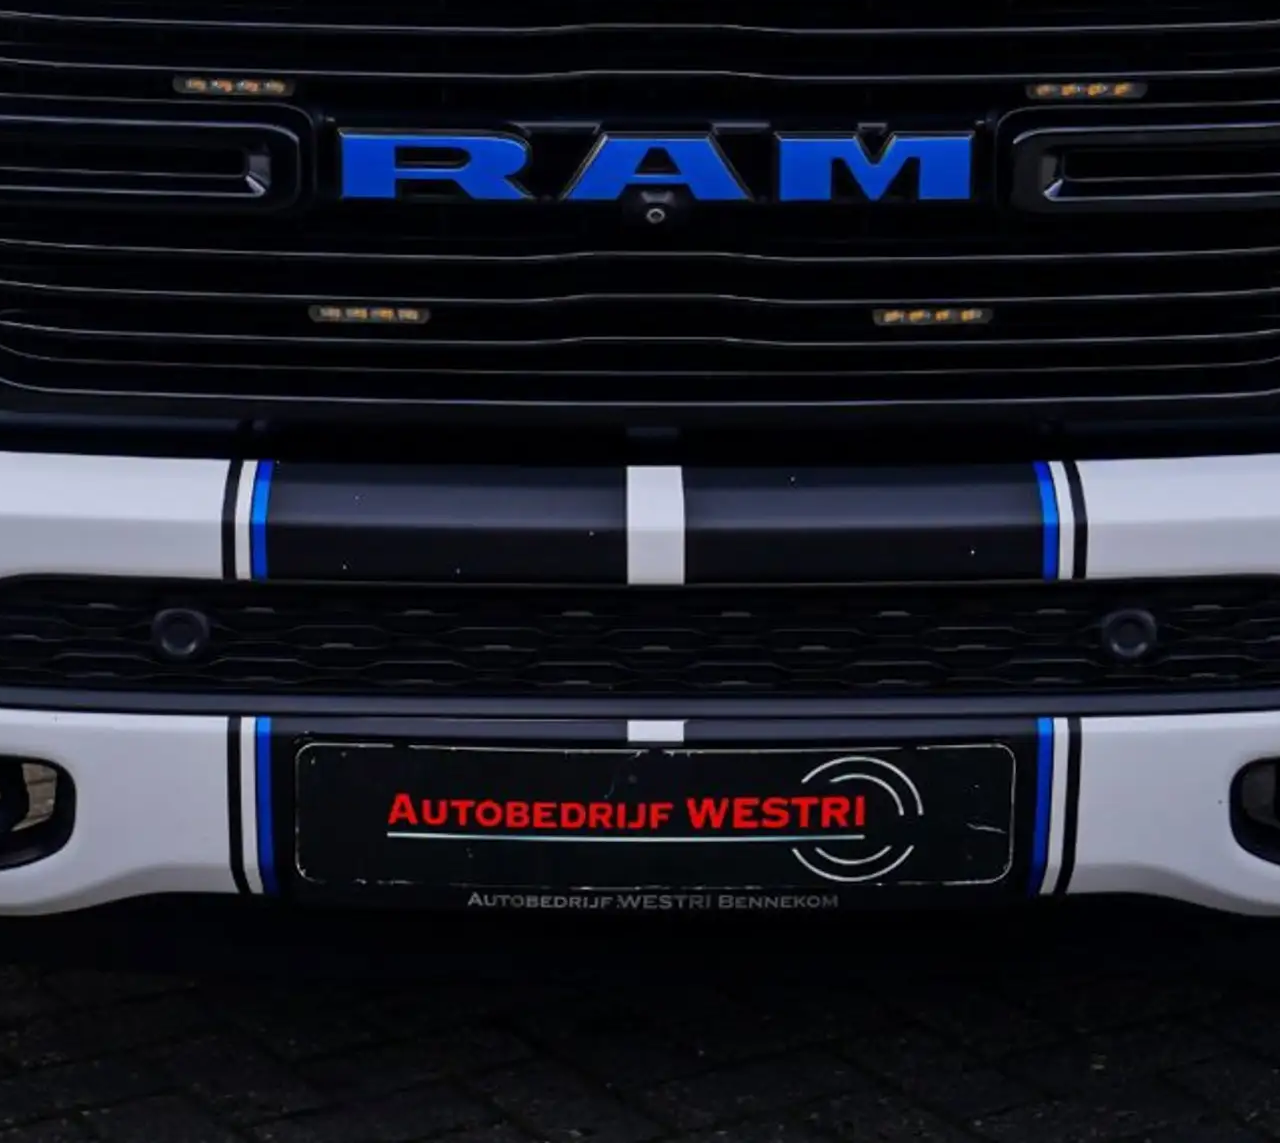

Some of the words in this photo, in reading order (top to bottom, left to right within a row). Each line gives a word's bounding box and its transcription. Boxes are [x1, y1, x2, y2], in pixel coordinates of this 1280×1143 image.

[337, 130, 974, 201] RAM
[387, 792, 675, 830] AUTOBEDRIJF
[685, 795, 866, 830] WESTRI
[467, 891, 614, 910] AUTOBEDRIJF
[618, 893, 712, 910] WESTRI
[717, 893, 840, 910] BENNEKOM
